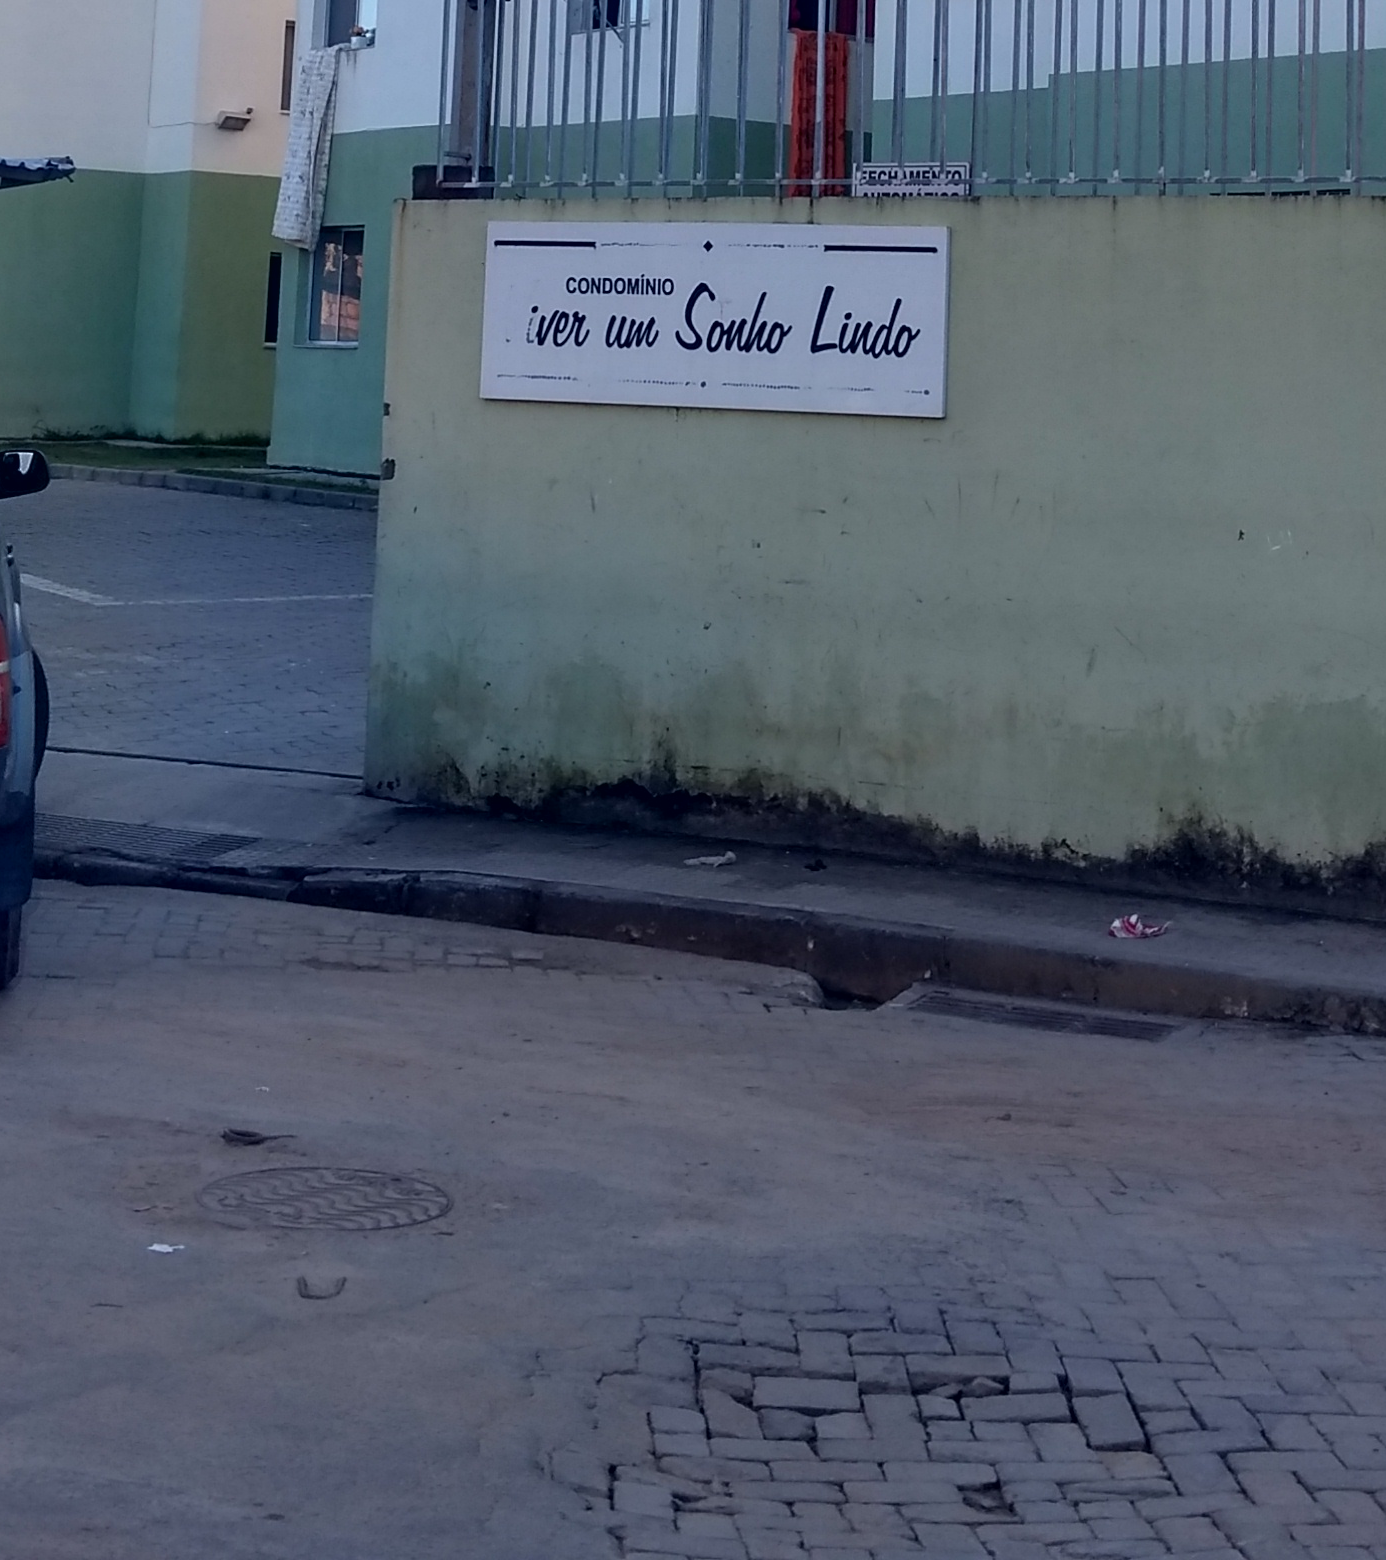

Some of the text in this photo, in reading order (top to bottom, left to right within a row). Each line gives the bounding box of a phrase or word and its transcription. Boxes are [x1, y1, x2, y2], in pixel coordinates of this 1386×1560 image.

[565, 274, 675, 296] CONDOMÍNIO
[674, 282, 792, 354] Sonho
[810, 285, 920, 359] Lindo
